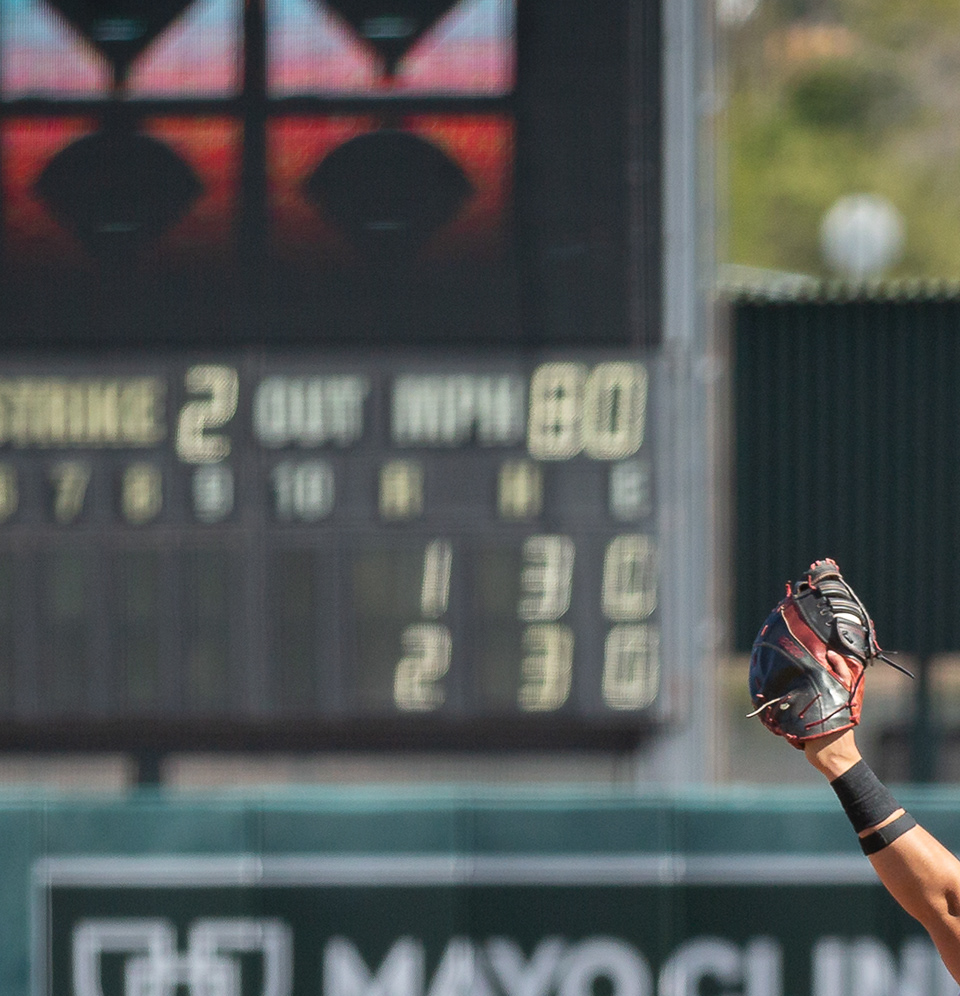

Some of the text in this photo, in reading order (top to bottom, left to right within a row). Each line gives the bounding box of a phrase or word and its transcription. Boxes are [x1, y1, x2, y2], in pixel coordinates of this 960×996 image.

[176, 363, 239, 464] 2
[253, 375, 370, 448] OUT
[528, 361, 649, 461] 80
[420, 537, 452, 620] 1
[517, 533, 576, 622] 3
[393, 622, 453, 713] 2
[517, 622, 575, 713] 3
